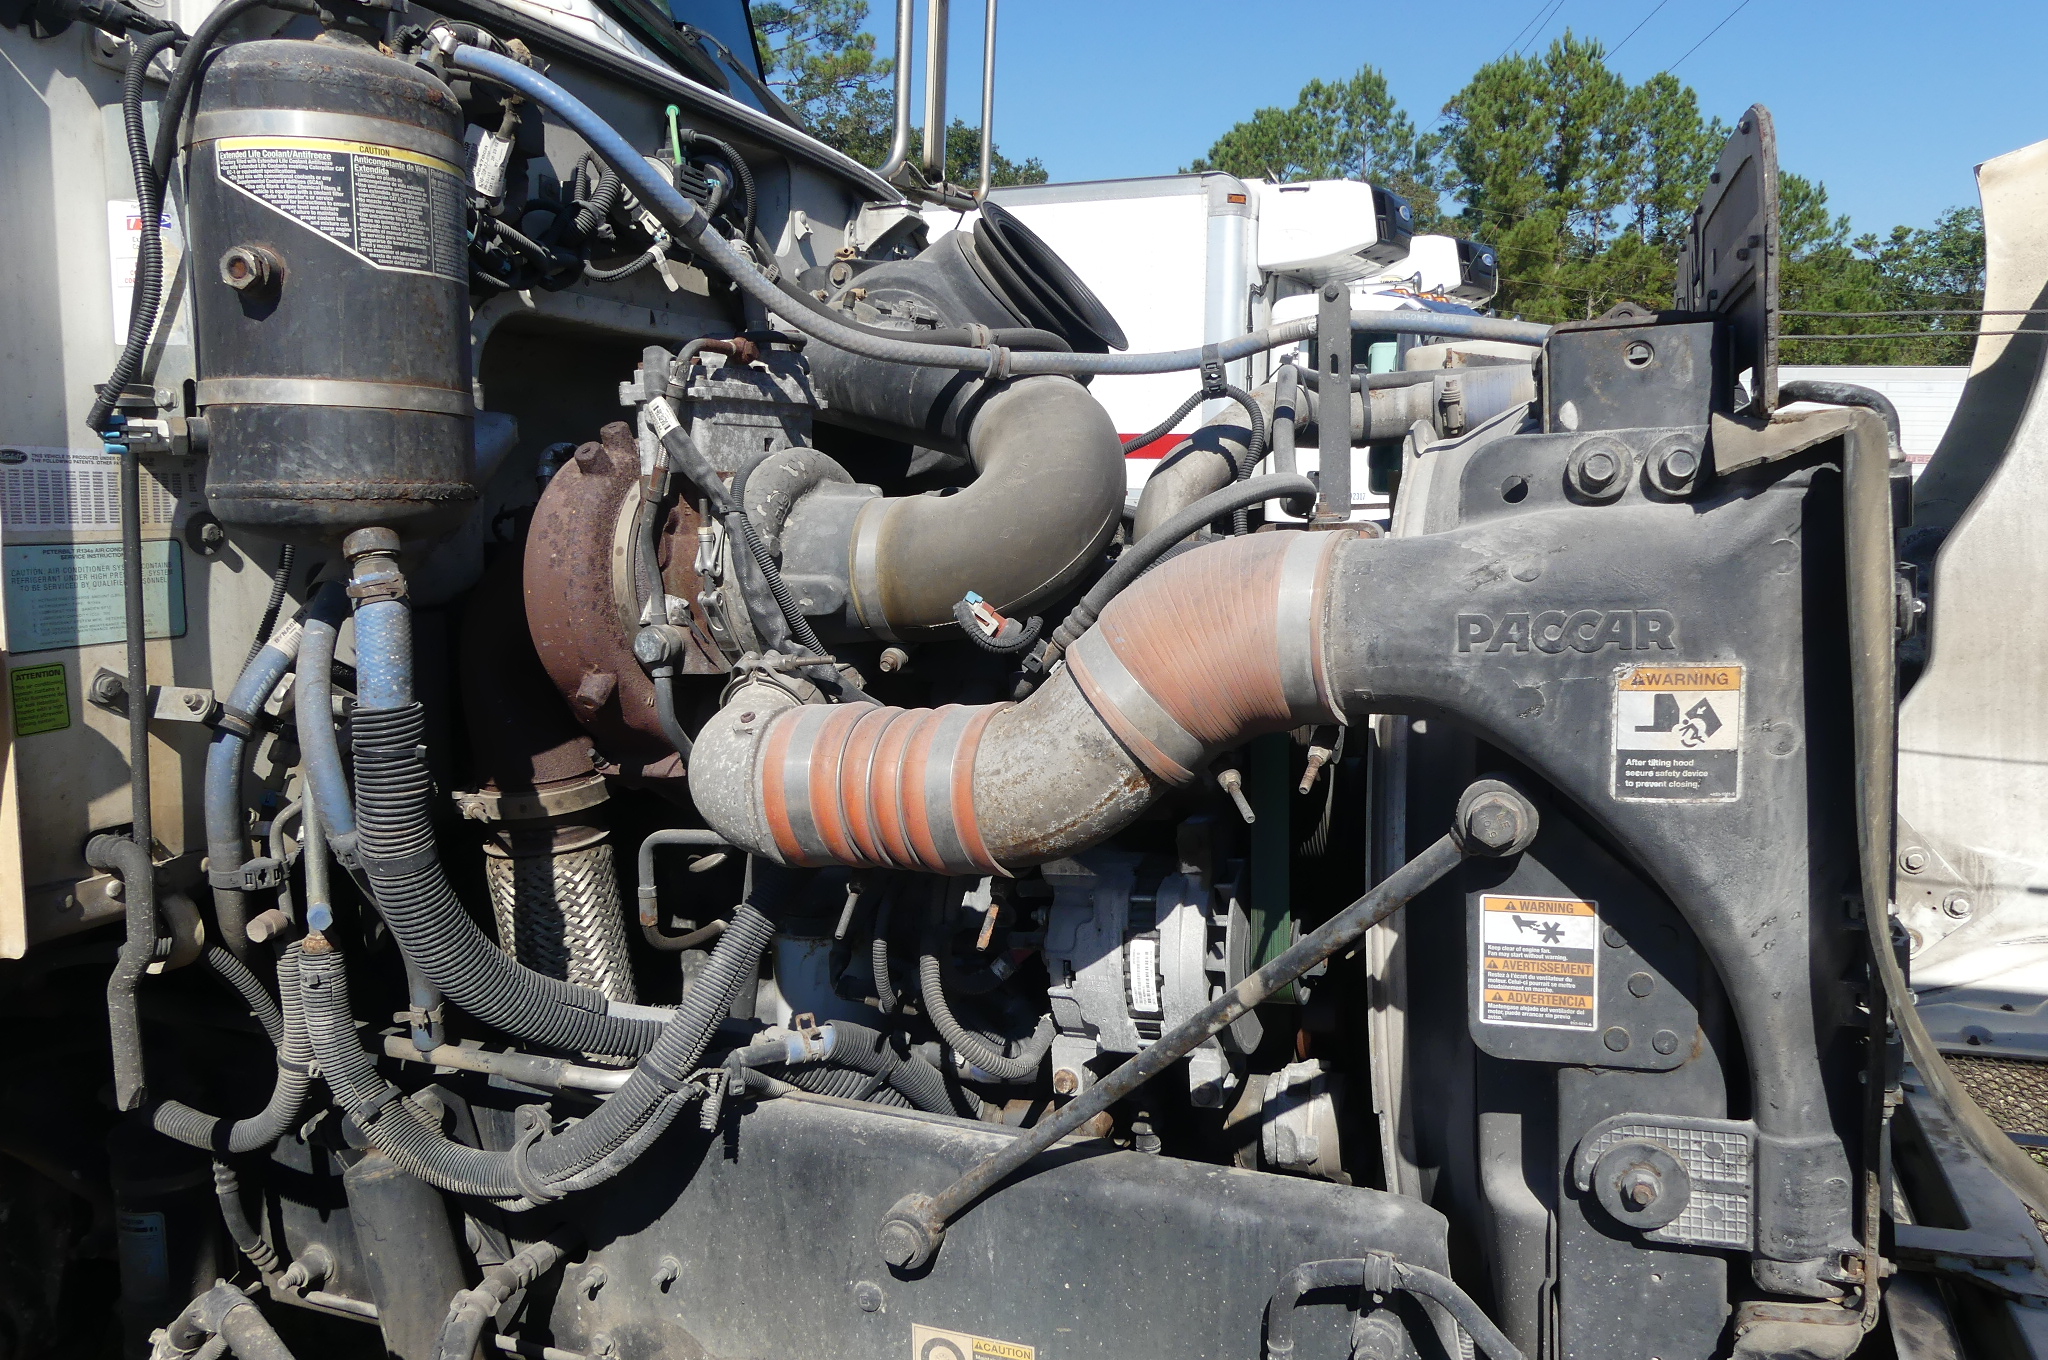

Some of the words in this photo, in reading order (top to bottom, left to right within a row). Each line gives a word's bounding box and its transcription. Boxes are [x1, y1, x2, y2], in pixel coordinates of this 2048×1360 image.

[220, 150, 247, 160] Extended
[248, 150, 261, 158] Life
[262, 150, 332, 160] Coolant/Antifreeze
[359, 145, 390, 156] CAUTION
[354, 163, 390, 176] Extendida
[1389, 313, 1429, 323] SILICONE
[1432, 314, 1467, 325] HEATER
[63, 565, 110, 574] CONDITIONER
[11, 575, 61, 585] REFRIGERANT
[63, 573, 88, 582] UNDER
[91, 572, 108, 580] HIGH
[31, 584, 41, 592] BE
[43, 581, 78, 591] SERVICED
[81, 581, 91, 589] BY
[1456, 608, 1676, 655] PACCAR
[15, 669, 62, 681] ATTENTION
[1647, 673, 1729, 687] WARNING
[1625, 758, 1647, 766] After
[1647, 758, 1672, 768] tilting
[1673, 759, 1694, 767] hood
[1655, 770, 1681, 779] safety
[1682, 769, 1709, 777] device
[1635, 780, 1667, 789] prevent
[1668, 780, 1700, 789] closing.
[1519, 900, 1574, 914] WARNING
[1545, 954, 1569, 962] warning.
[1502, 959, 1592, 975] AVERTISSEMENT
[1487, 983, 1524, 991] soudainement
[1507, 991, 1586, 1007] ADVERTENCIA
[1519, 1004, 1539, 1012] alejado
[1549, 1006, 1575, 1014] ventilador
[1553, 1013, 1571, 1021] previo
[983, 1342, 1032, 1360] CAUTION
